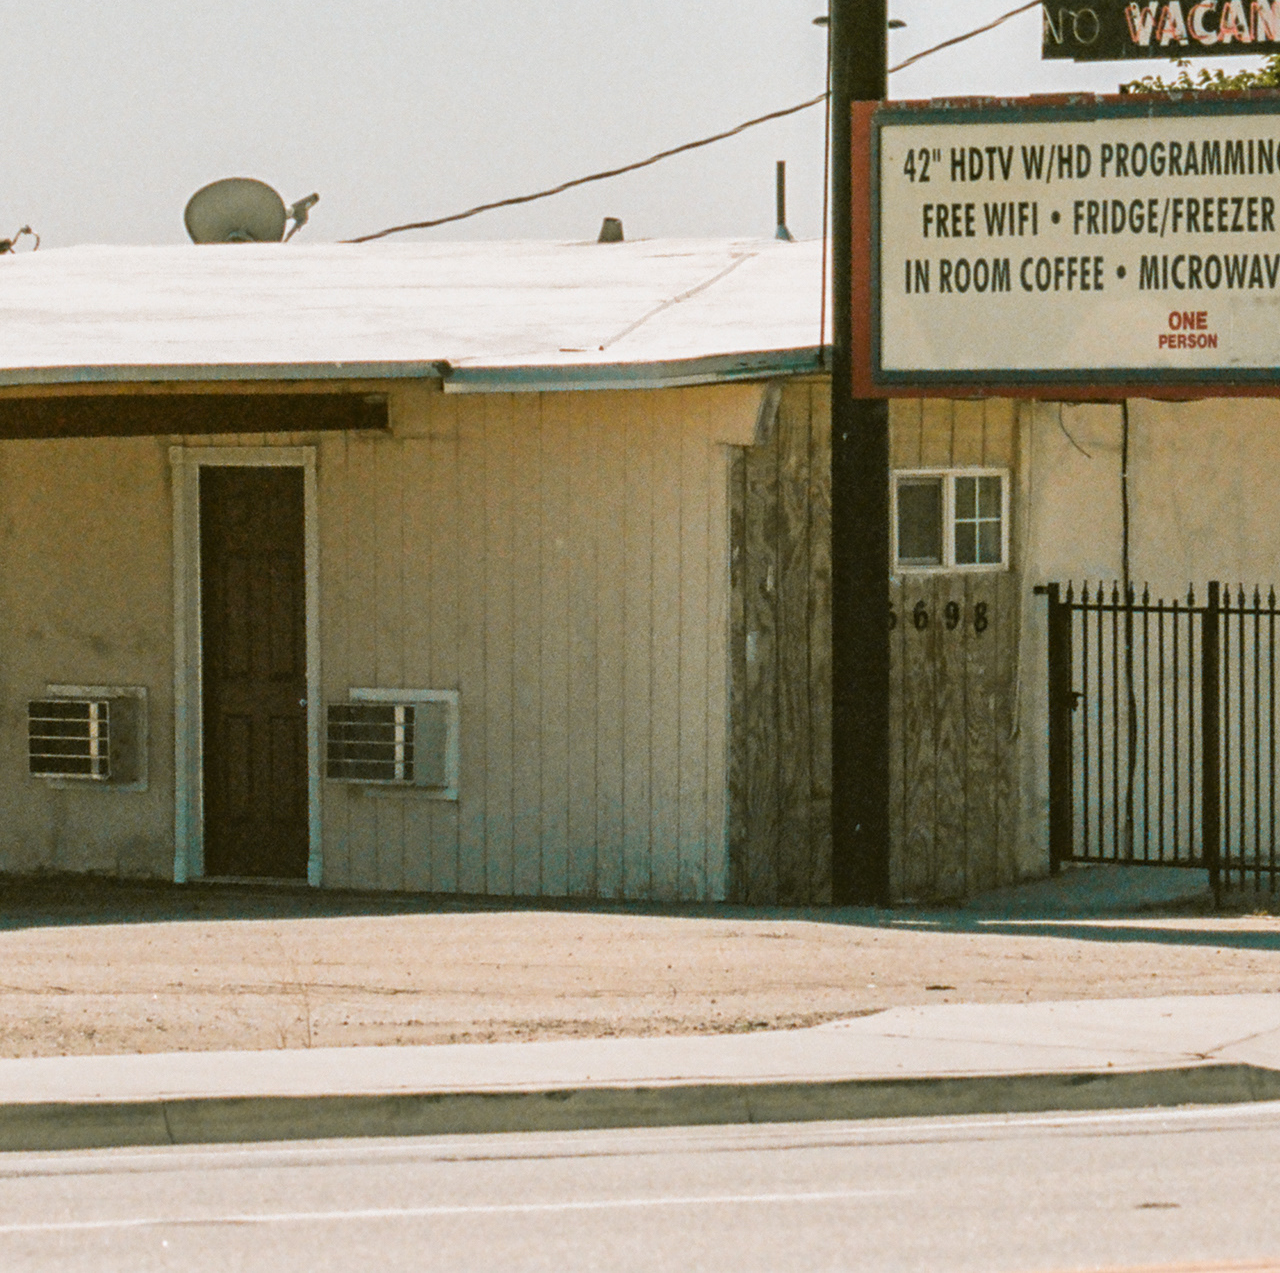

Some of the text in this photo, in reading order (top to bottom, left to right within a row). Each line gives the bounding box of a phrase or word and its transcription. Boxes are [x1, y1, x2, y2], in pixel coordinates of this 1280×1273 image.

[1042, 5, 1100, 45] NO
[903, 147, 942, 183] 42"
[950, 146, 1014, 181] HDTV
[1021, 143, 1092, 184] W/HD
[922, 196, 1276, 238] FREE WIFI FRIDGE/FREEZER
[904, 259, 930, 294] IN
[938, 258, 1012, 293] ROOM
[1020, 256, 1105, 292] COFFEE
[1168, 310, 1208, 331] ONE
[1158, 332, 1218, 350] PERSON
